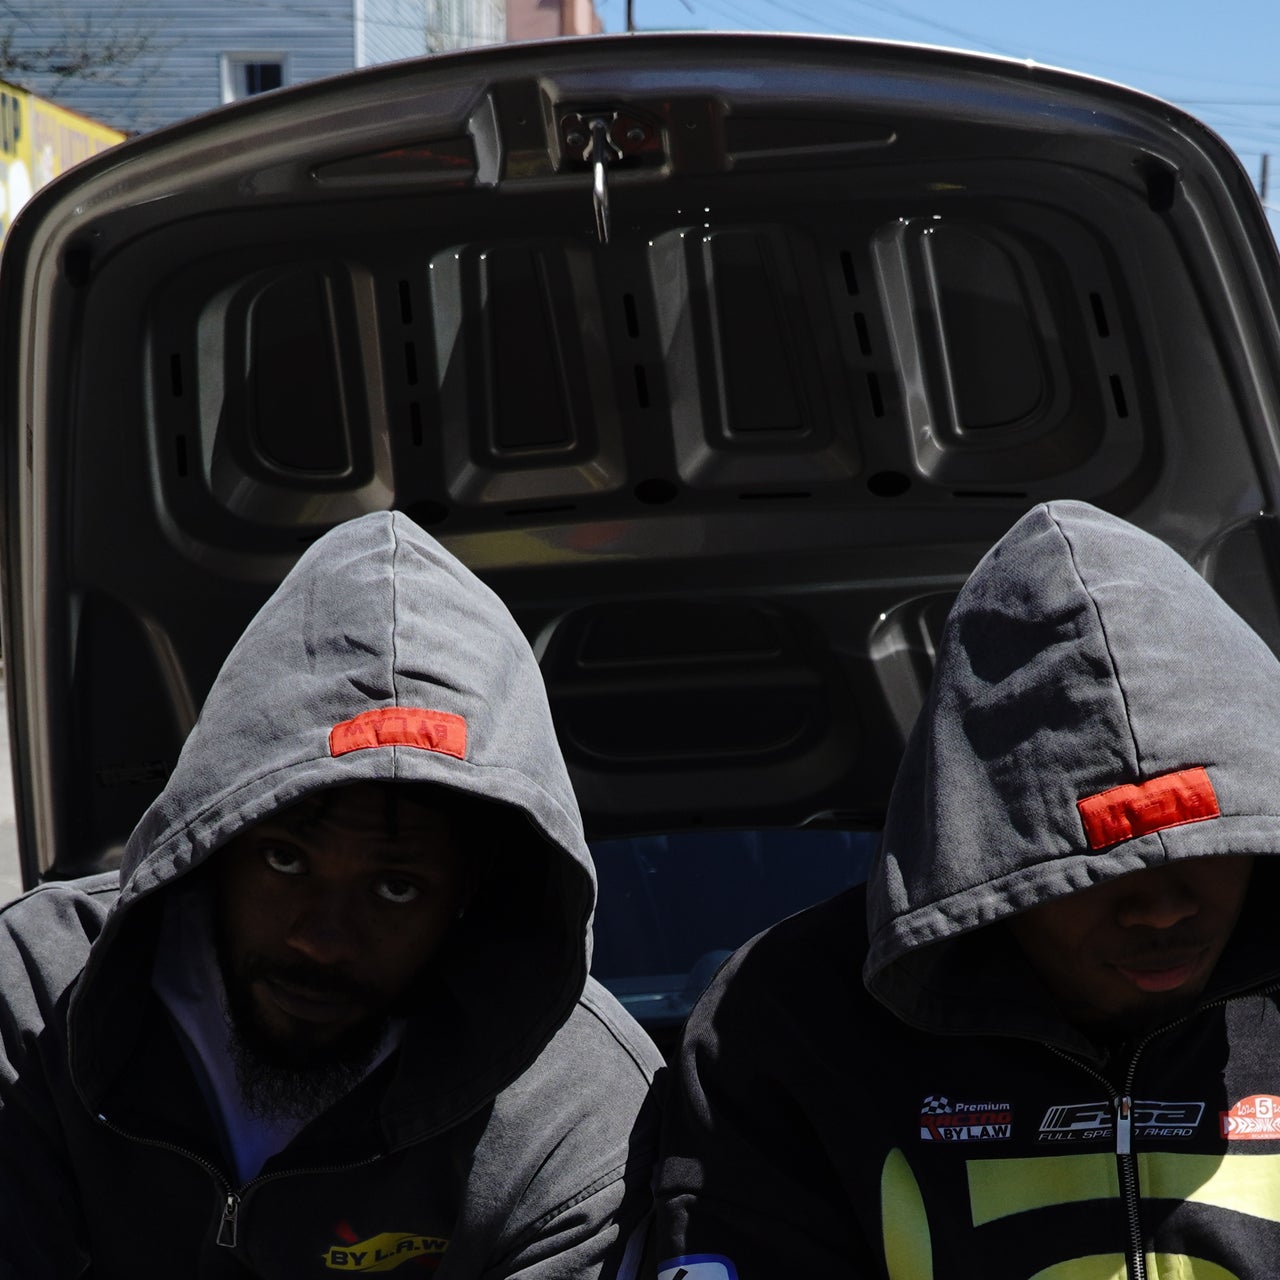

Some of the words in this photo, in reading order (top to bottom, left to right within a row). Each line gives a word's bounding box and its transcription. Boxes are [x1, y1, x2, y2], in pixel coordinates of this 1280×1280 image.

[955, 1101, 1010, 1113] Premium
[944, 1127, 963, 1140] BY
[1039, 1132, 1076, 1141] FULL
[1144, 1128, 1193, 1137] AHEAD
[330, 1250, 367, 1267] BY
